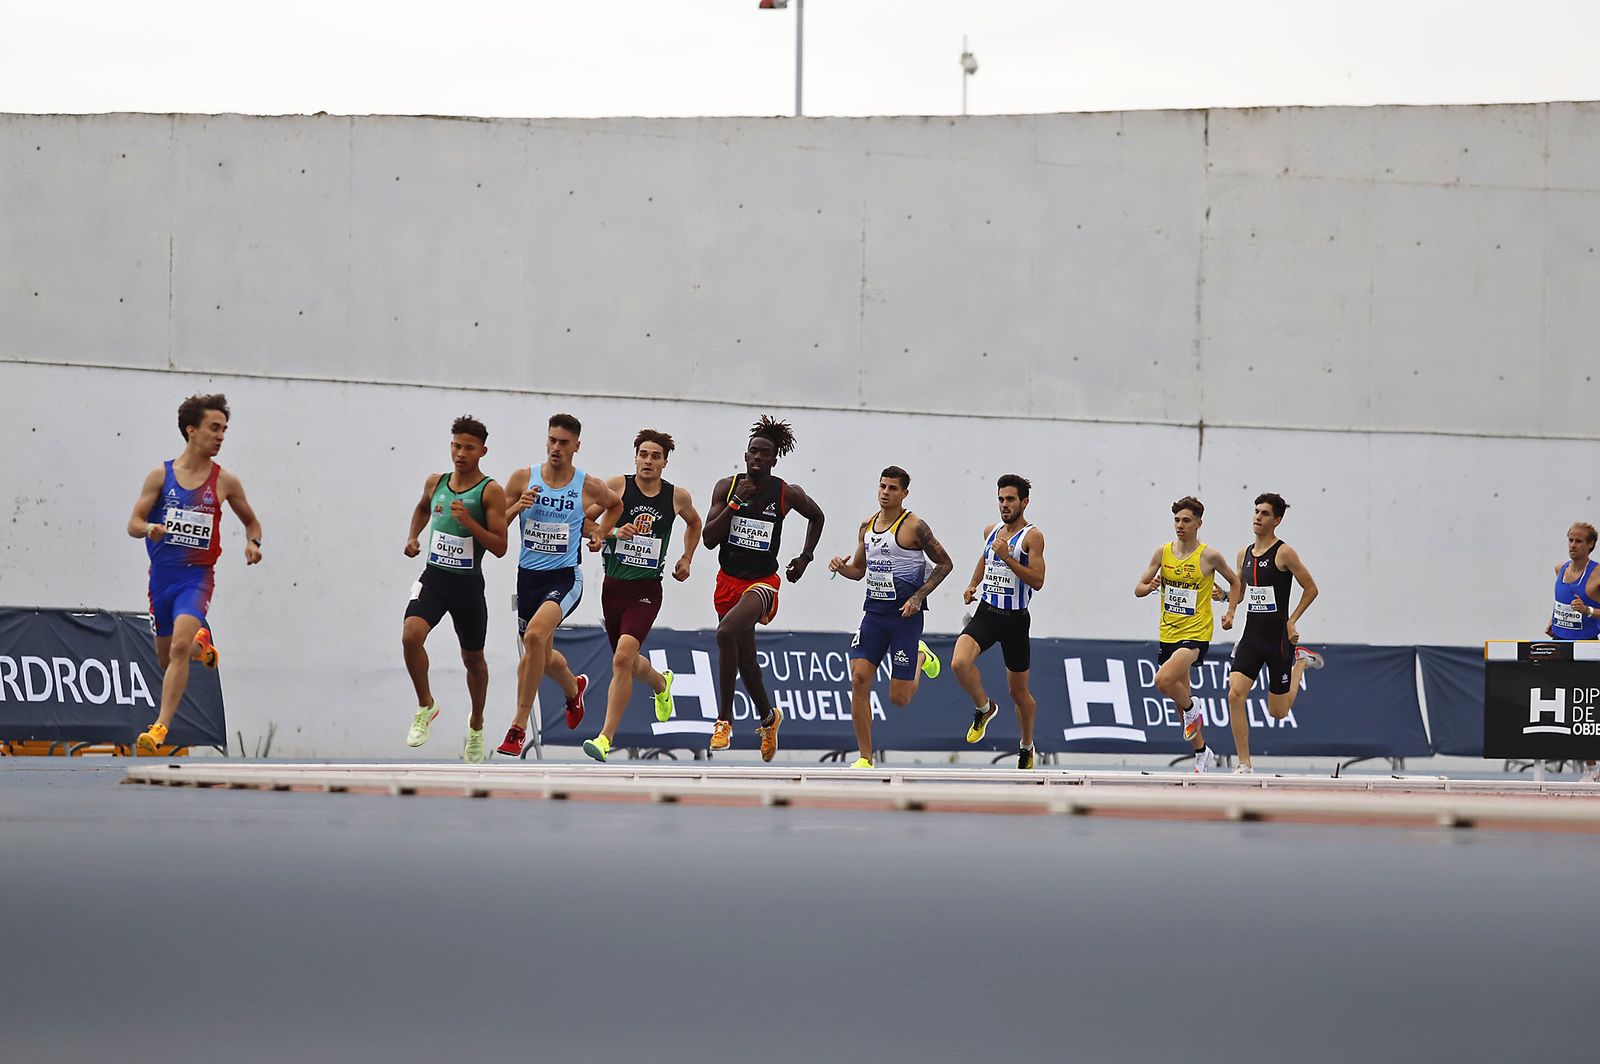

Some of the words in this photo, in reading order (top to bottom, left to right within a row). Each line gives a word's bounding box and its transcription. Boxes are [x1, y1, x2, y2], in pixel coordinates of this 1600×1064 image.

[166, 520, 211, 537] PACER
[525, 529, 568, 540] MARTINEZ
[733, 525, 769, 538] VIAFARA
[437, 543, 464, 554] OLIVO
[624, 543, 652, 555] BADIA
[0, 655, 155, 707] RDROLA
[1573, 688, 1600, 704] DIP
[774, 690, 887, 720] HUELA
[1143, 697, 1181, 726] DE
[1573, 706, 1595, 722] DE
